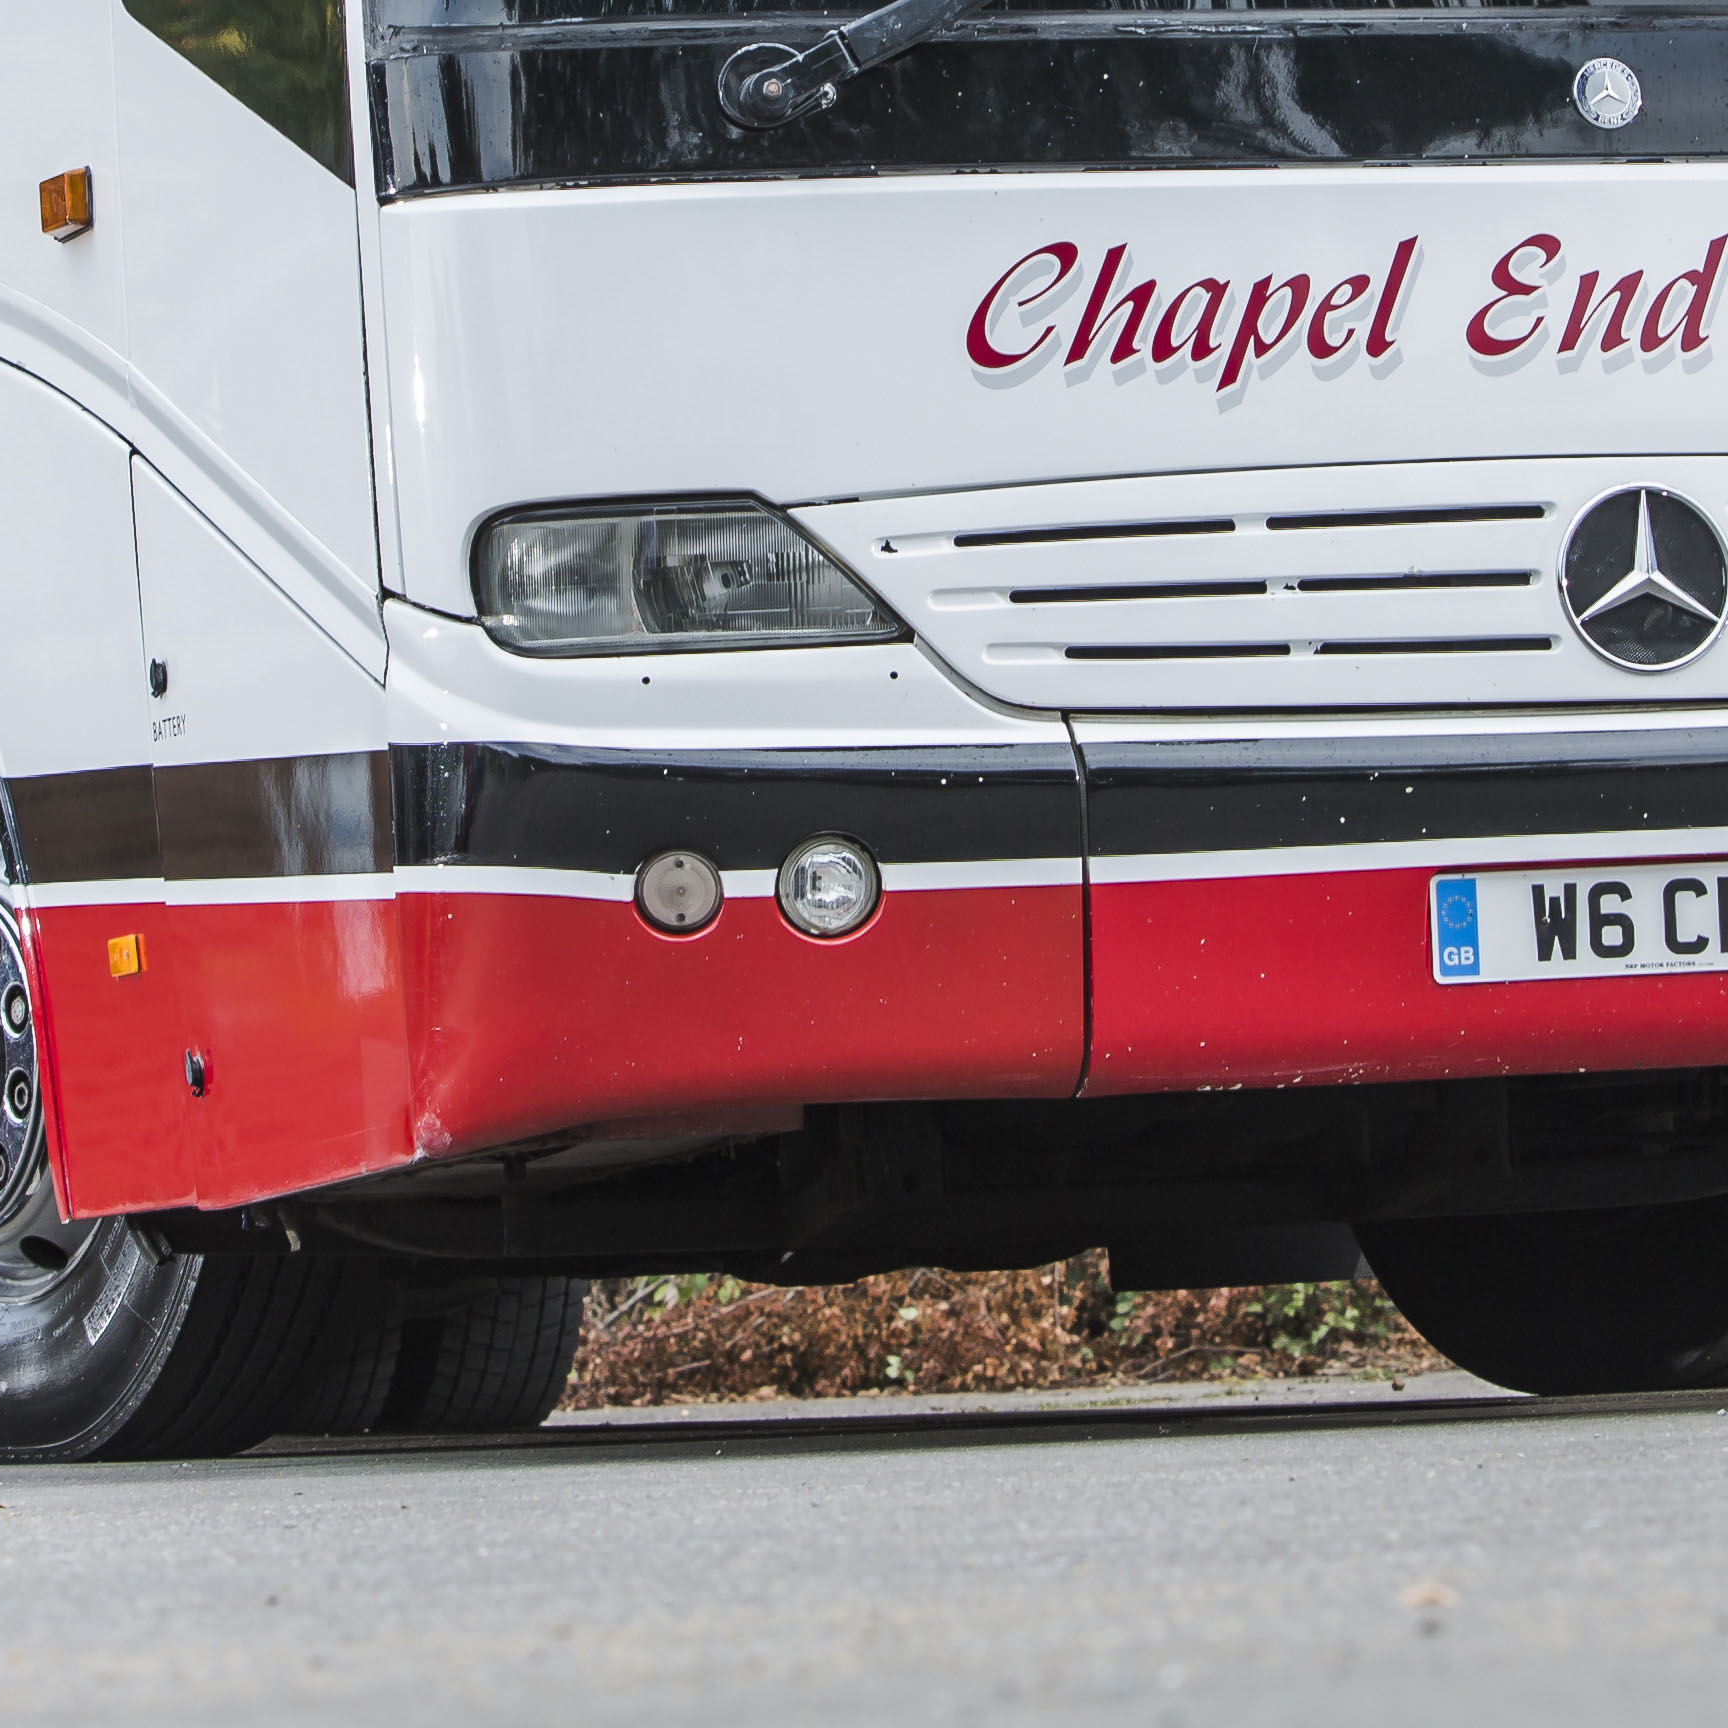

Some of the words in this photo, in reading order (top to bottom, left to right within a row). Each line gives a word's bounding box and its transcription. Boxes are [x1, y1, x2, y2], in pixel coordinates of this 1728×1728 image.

[965, 236, 1419, 392] Chapel
[152, 713, 187, 742] BATTERY
[1531, 881, 1635, 962] W6
[1443, 946, 1475, 966] GB
